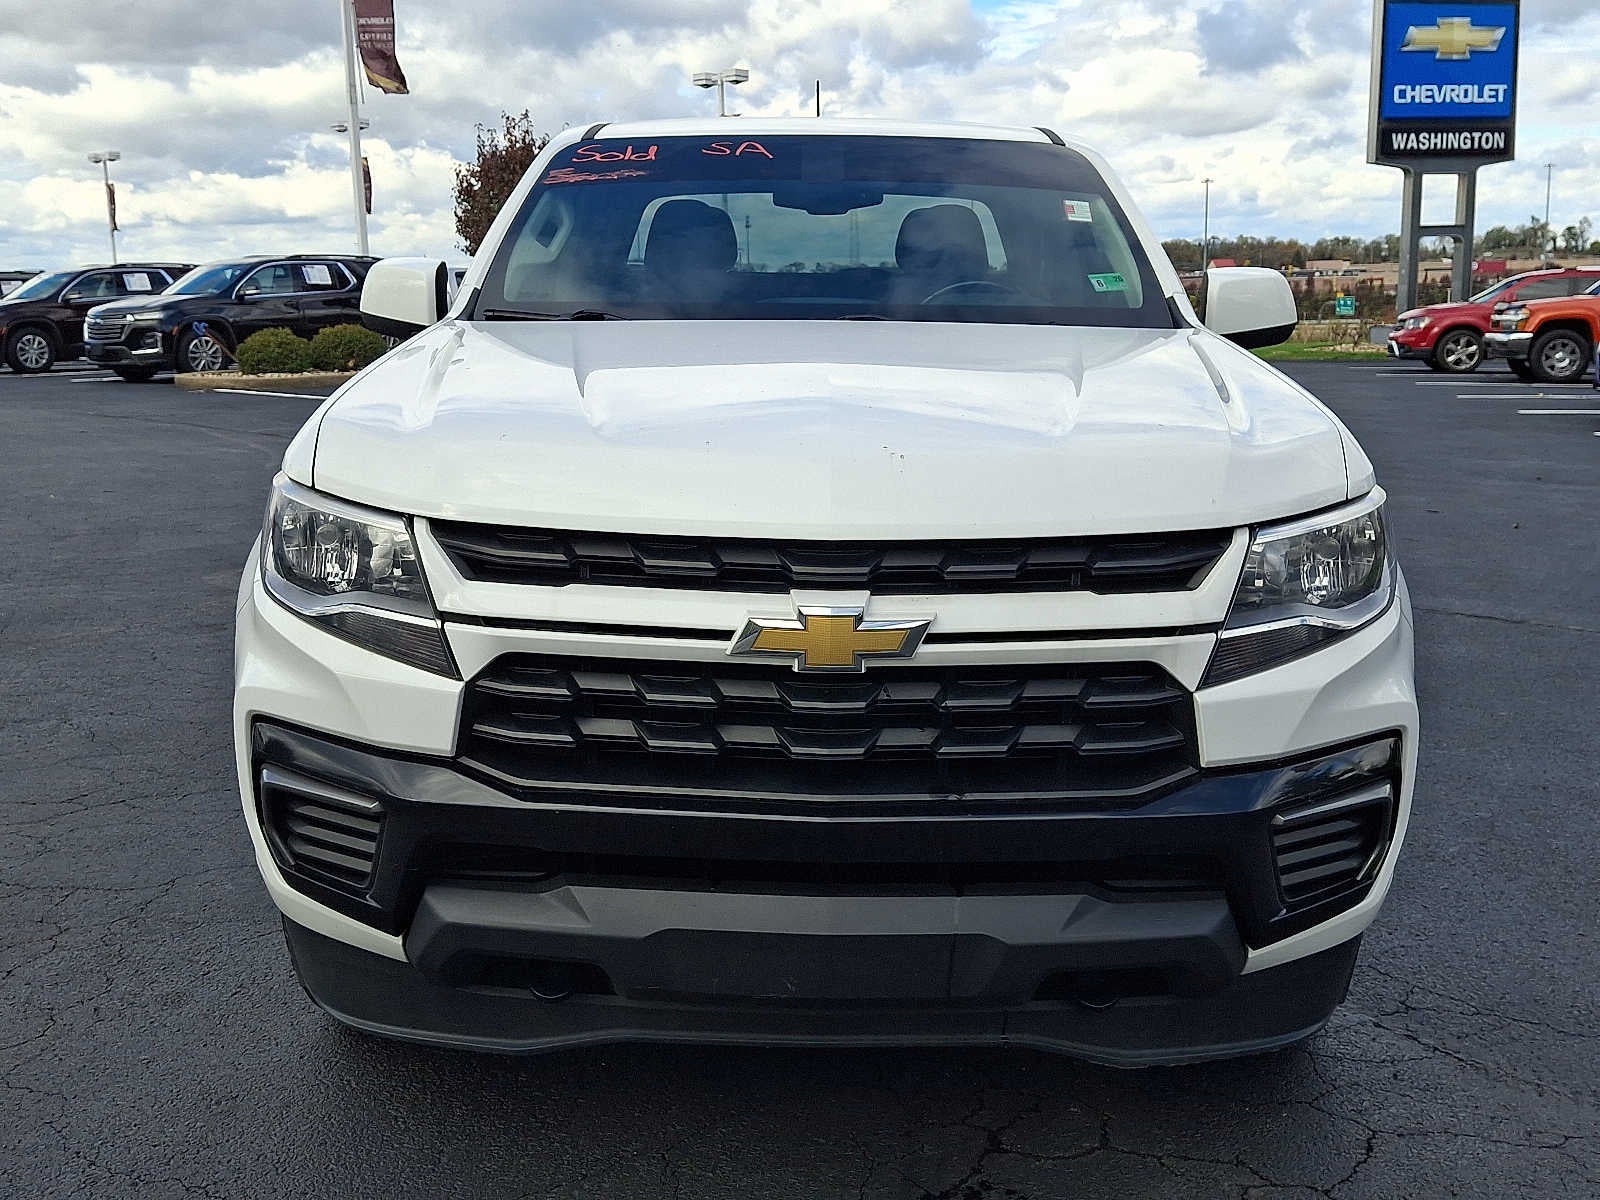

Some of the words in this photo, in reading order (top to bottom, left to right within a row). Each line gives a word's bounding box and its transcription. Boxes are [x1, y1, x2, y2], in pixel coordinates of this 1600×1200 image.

[1393, 84, 1508, 104] CHEVROLET
[1391, 132, 1505, 150] WASHINGTON
[572, 144, 658, 162] Sold
[702, 141, 774, 160] SA
